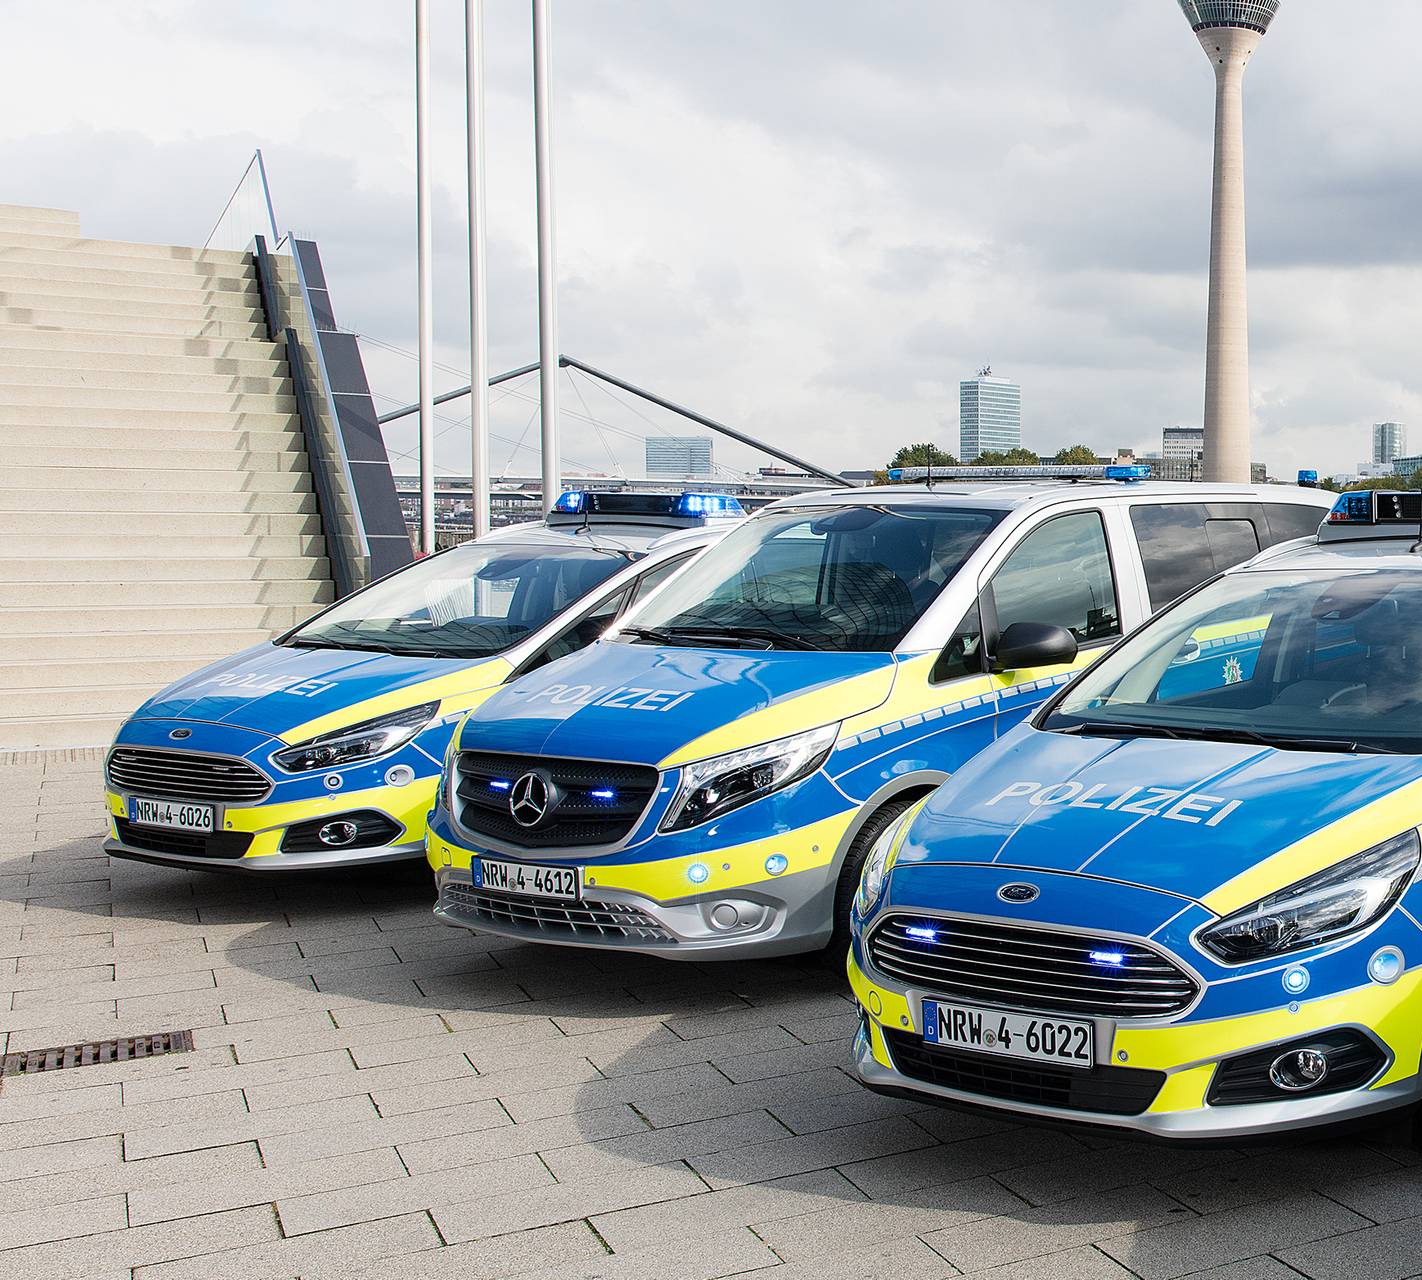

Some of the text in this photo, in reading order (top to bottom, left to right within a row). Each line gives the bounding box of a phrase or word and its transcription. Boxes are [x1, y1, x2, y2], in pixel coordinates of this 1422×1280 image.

[526, 684, 696, 712] POLIZEI
[136, 800, 211, 828] NRW 4-6026
[985, 781, 1244, 827] POLIZEI
[481, 862, 575, 896] NRW 4-4612
[927, 1025, 935, 1035] D
[938, 1006, 1089, 1061] NRW 4-6022
